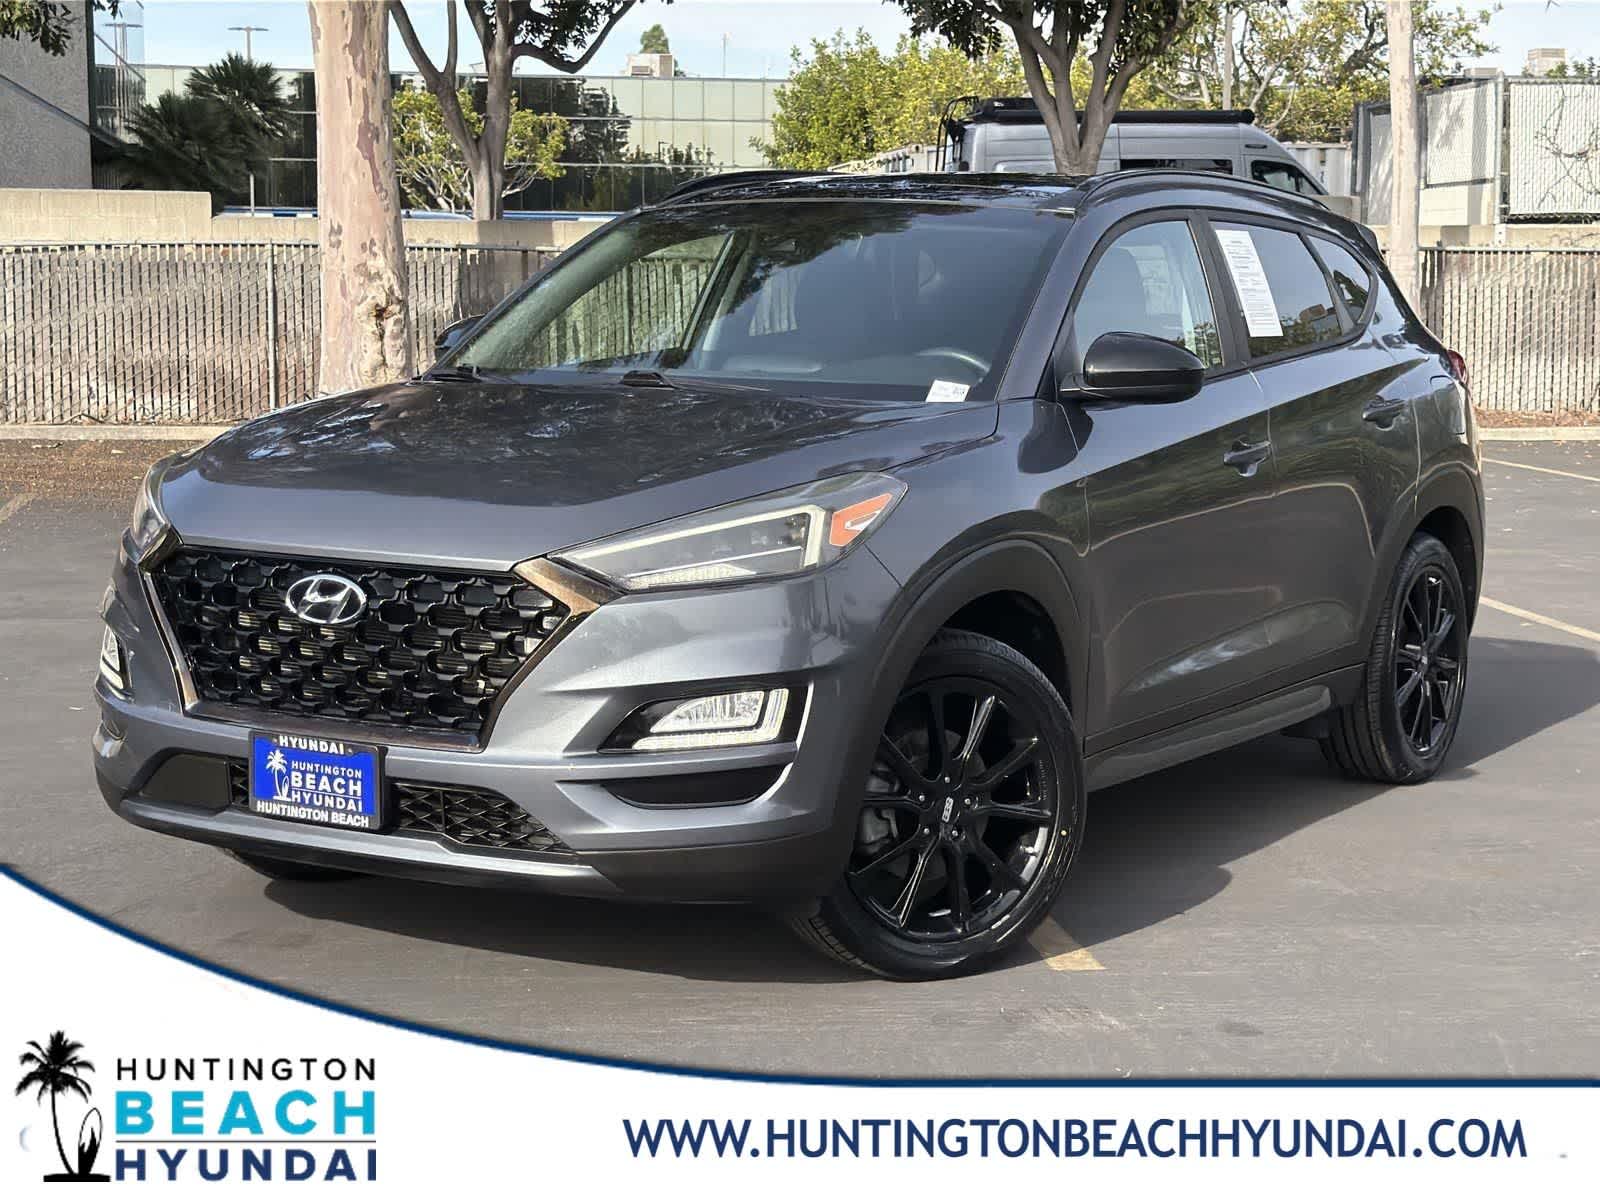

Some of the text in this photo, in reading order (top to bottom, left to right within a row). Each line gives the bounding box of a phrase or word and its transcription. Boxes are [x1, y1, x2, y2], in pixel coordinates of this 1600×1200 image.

[278, 735, 345, 755] HYUNDAI
[291, 760, 362, 779] HUNTINGTON
[291, 771, 362, 797] BEACH
[291, 790, 363, 812] HYUNDAI
[256, 800, 369, 828] HUNTINGTON BEACH
